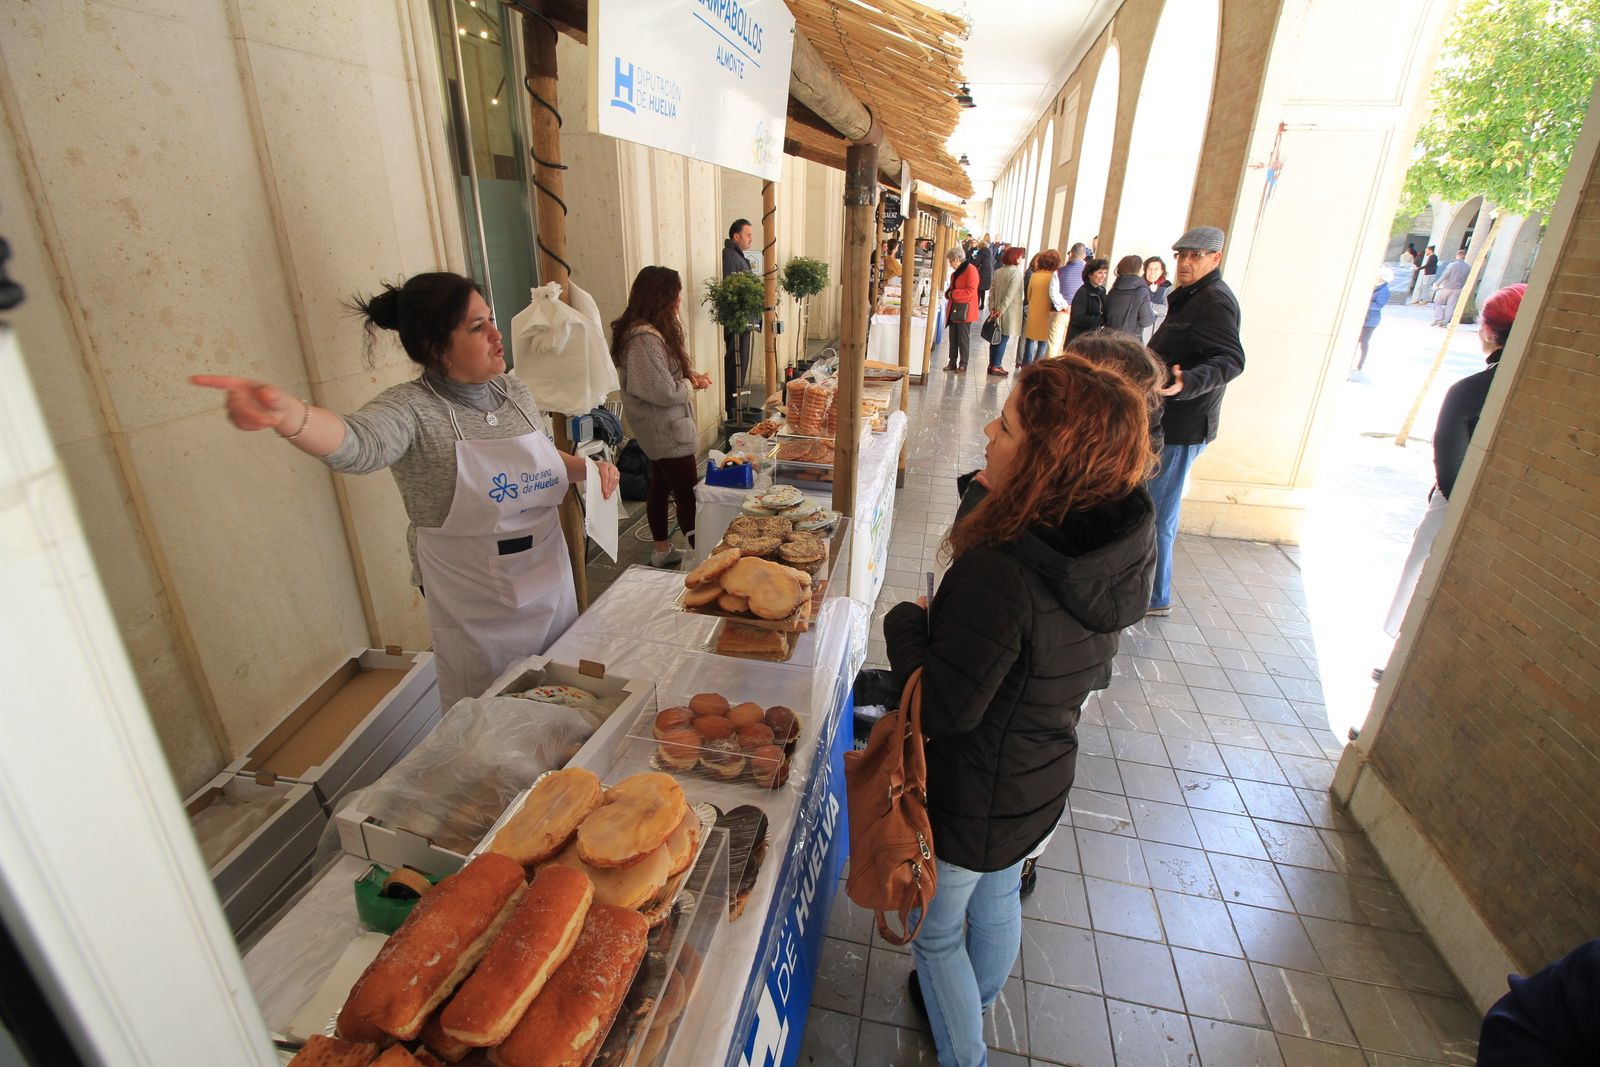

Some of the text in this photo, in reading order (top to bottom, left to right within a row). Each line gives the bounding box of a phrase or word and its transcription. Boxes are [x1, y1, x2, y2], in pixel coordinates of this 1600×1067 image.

[698, 0, 763, 54] MPABOLLOS
[716, 45, 744, 79] ALMONTE
[637, 66, 681, 101] DIPUTACIÓN
[637, 89, 677, 119] DE HUELVA
[521, 469, 552, 483] Que sea
[523, 477, 559, 494] de Huelva
[777, 933, 798, 1007] DE
[795, 792, 840, 937] HUELVA
